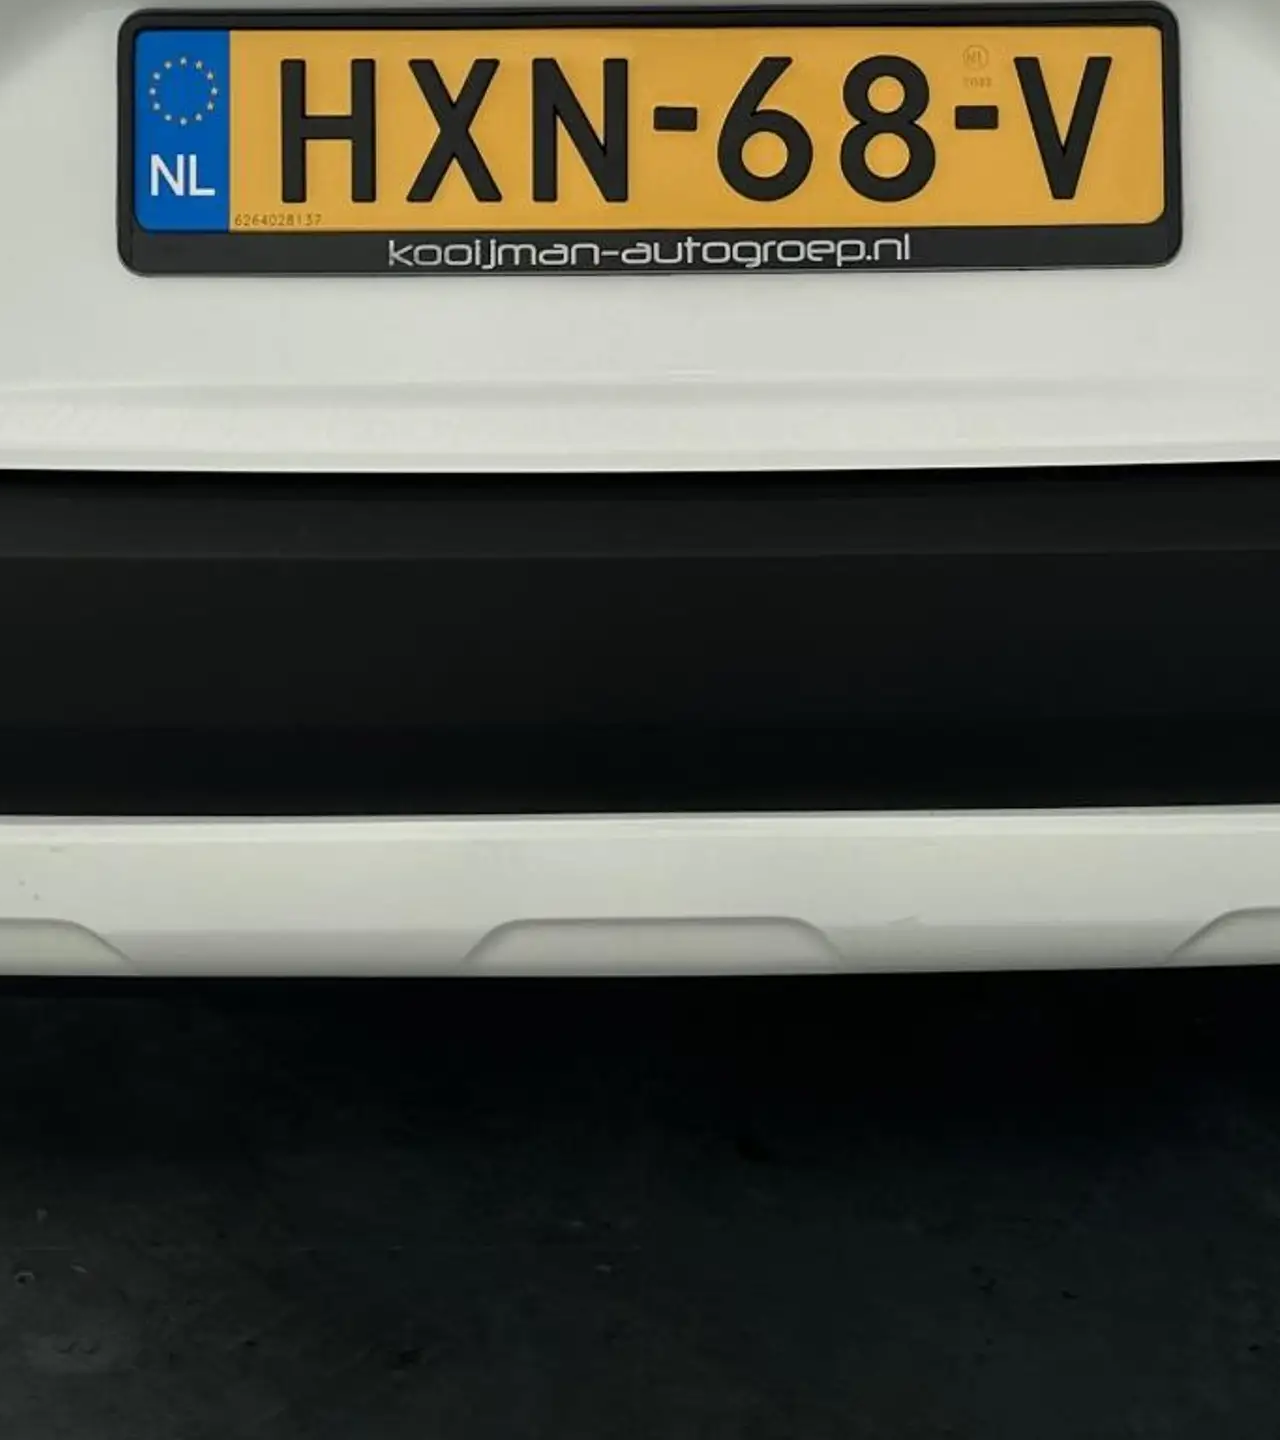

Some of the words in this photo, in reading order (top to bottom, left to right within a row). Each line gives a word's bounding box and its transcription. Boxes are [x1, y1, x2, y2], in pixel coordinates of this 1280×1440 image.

[279, 54, 1113, 204] HXN-68-V
[150, 153, 217, 197] NL
[388, 233, 912, 269] kooijman-autogroep.nl
